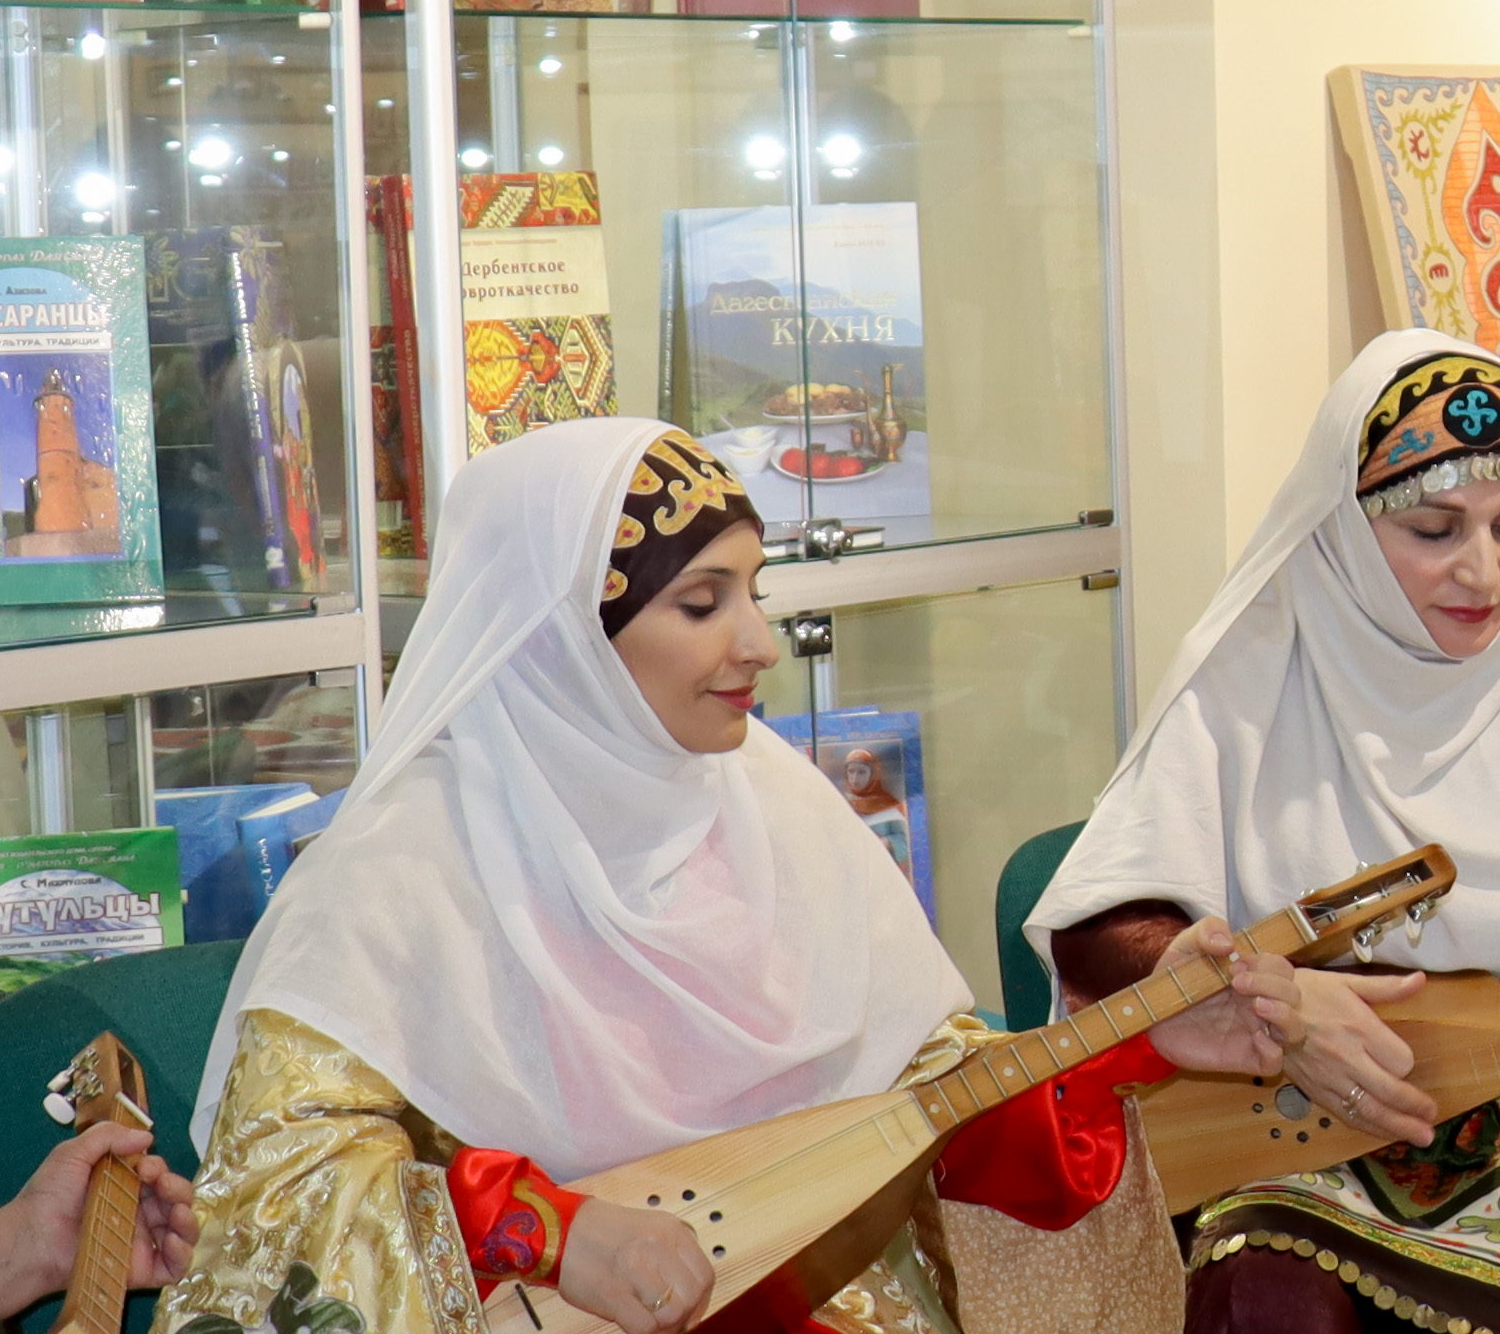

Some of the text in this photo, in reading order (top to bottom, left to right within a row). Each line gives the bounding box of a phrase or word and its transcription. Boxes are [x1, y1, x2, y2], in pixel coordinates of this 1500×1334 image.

[462, 283, 579, 302] овроткачество
[771, 314, 895, 345] КУХНЯ
[45, 338, 99, 346] ТРАДИЦИИ
